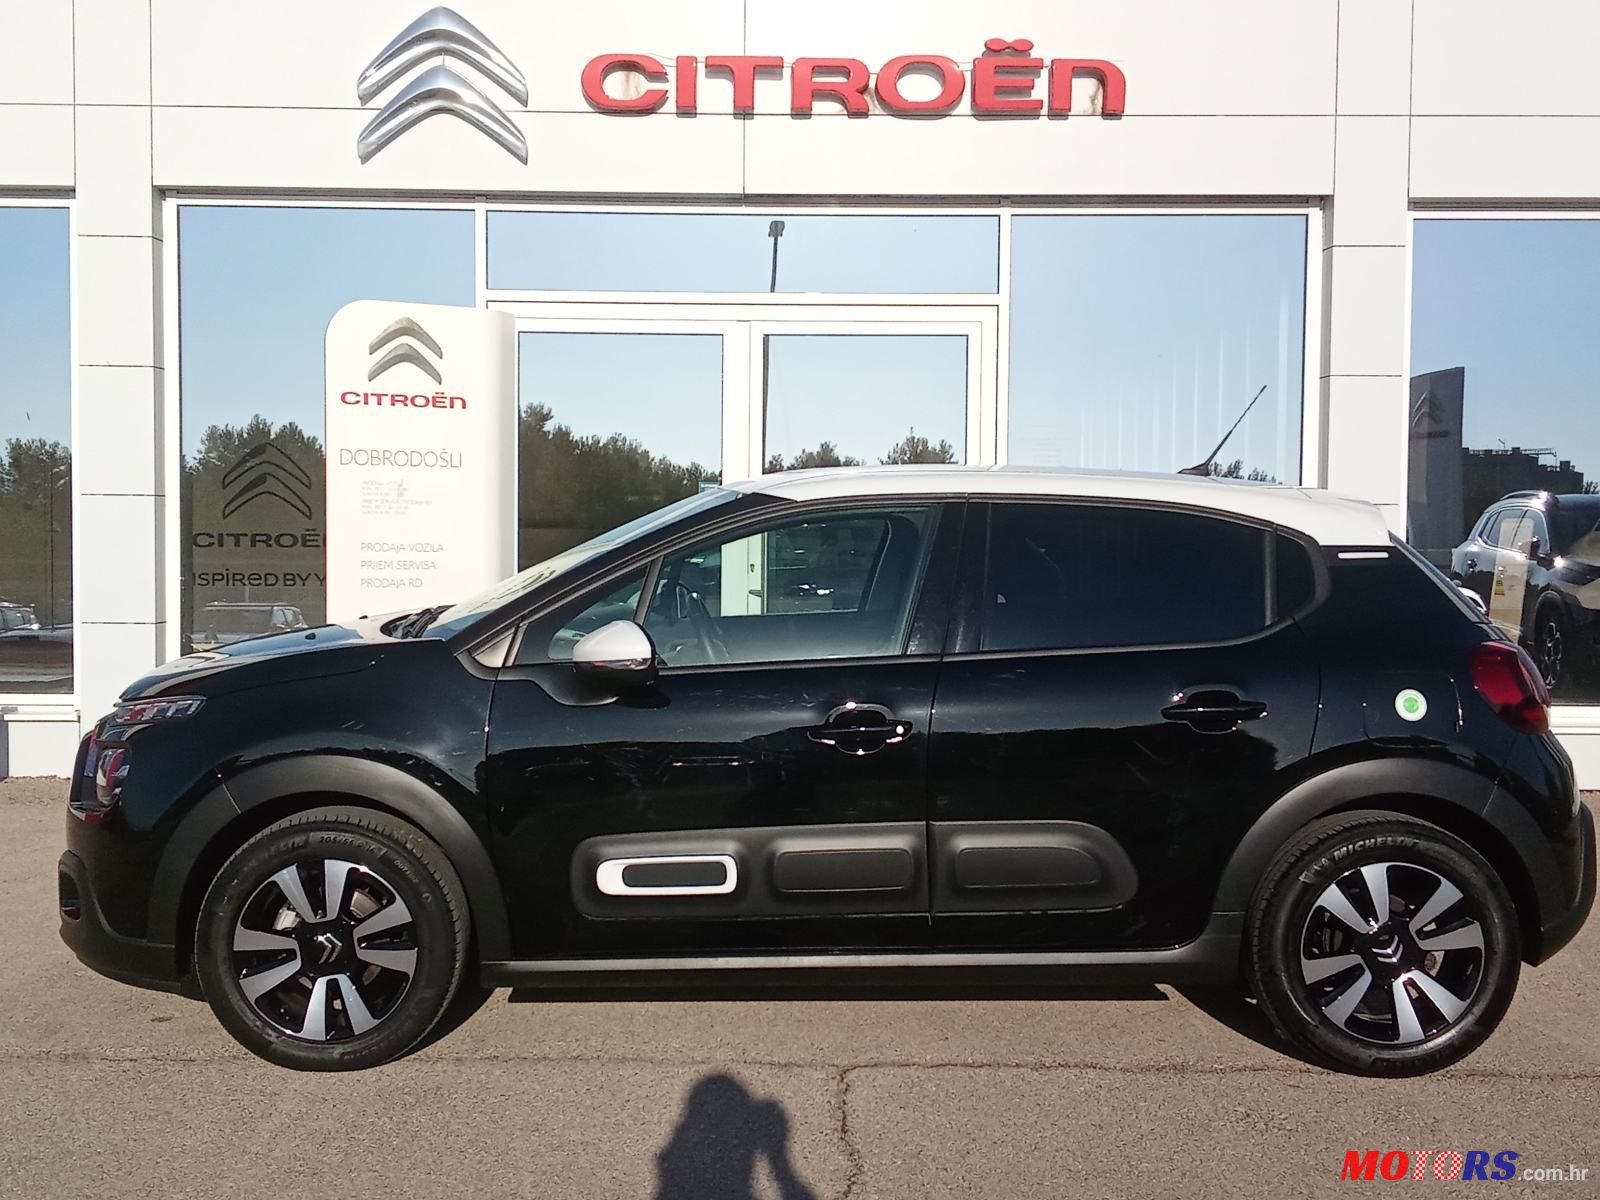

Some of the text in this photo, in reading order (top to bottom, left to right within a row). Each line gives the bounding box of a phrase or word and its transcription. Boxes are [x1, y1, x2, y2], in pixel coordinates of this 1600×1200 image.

[339, 448, 462, 468] DOBRODOŠLI
[360, 542, 445, 553] PRODAJA VOZILA
[360, 560, 437, 571] PRIJEM SERVISA
[283, 572, 312, 587] BY
[360, 578, 423, 590] PRODAJA RD
[1333, 836, 1417, 861] MICHELIN
